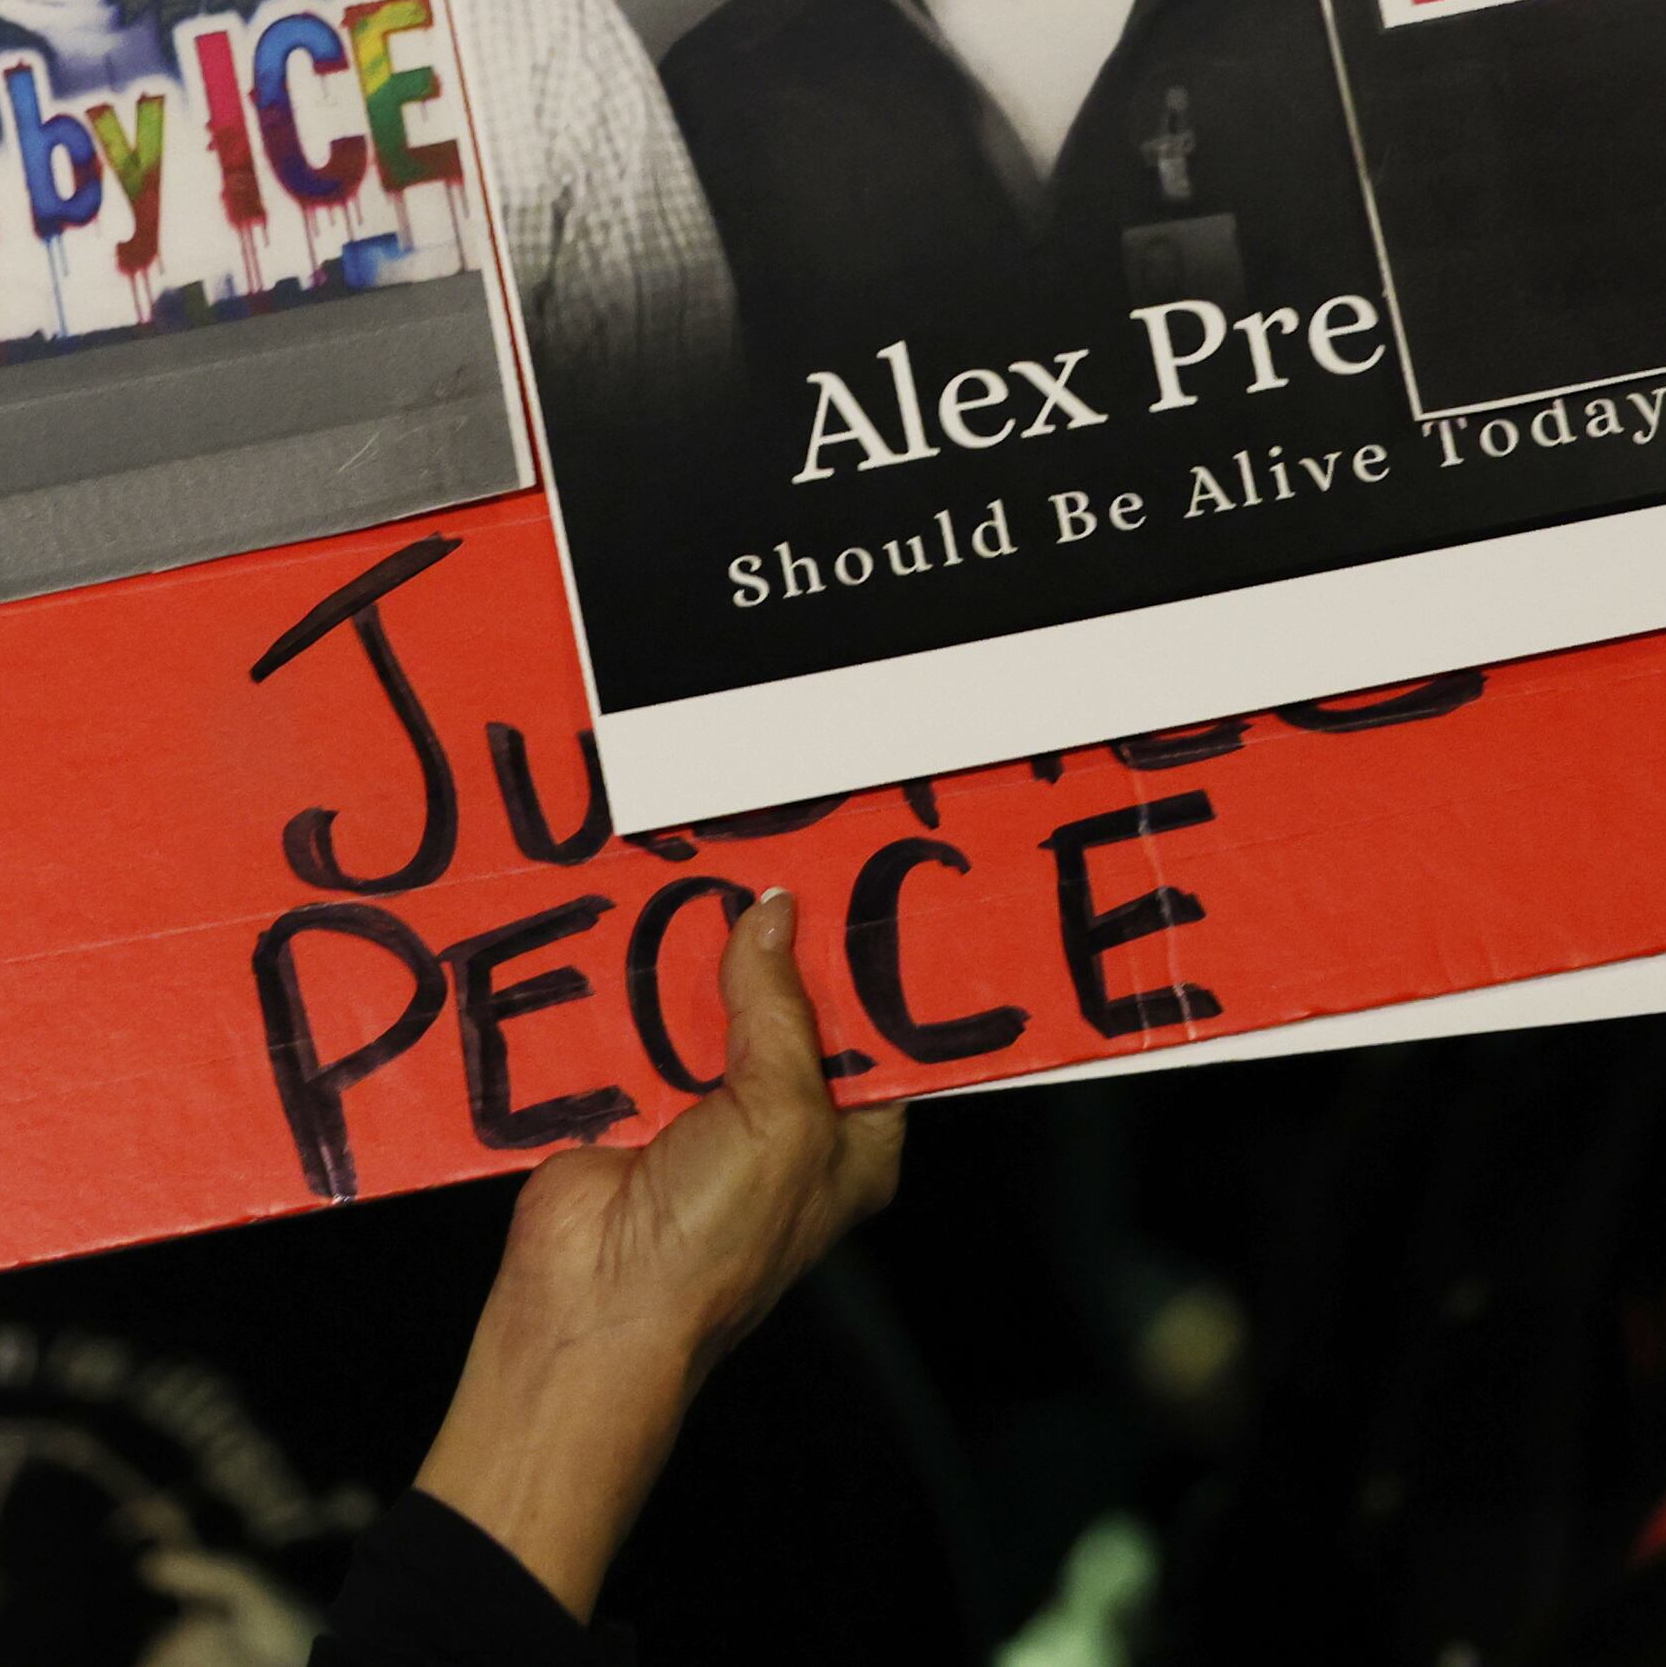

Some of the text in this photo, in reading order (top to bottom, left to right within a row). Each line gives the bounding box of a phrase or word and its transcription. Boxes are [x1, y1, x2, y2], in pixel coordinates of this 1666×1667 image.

[6, 61, 165, 274] by
[790, 294, 1390, 487] Alex Pre
[729, 498, 1019, 609] Should
[1048, 486, 1147, 546] Be
[1183, 440, 1391, 520] Alive
